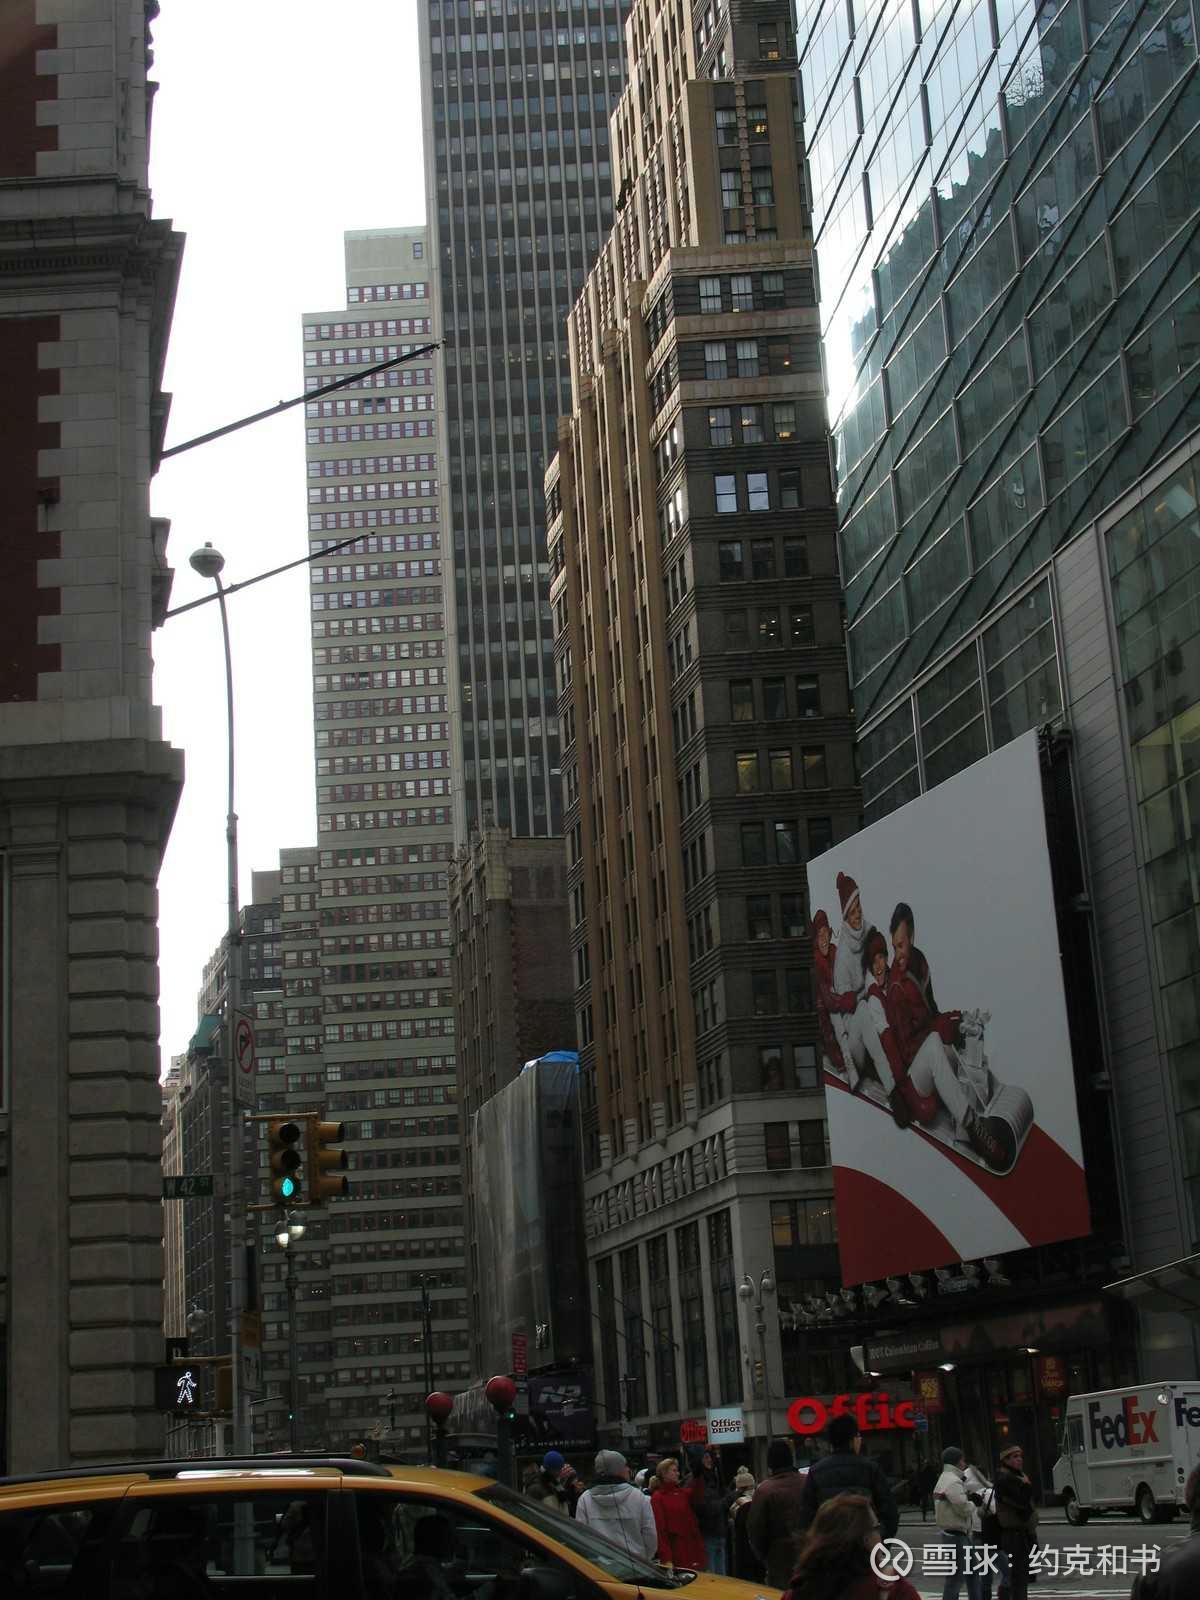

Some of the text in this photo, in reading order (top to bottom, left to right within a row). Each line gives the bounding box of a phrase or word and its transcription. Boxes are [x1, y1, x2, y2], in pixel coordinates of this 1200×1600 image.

[180, 1178, 195, 1195] 42
[711, 1418, 741, 1428] Office
[1088, 1395, 1159, 1449] FedEx
[712, 1426, 742, 1434] DEPOT
